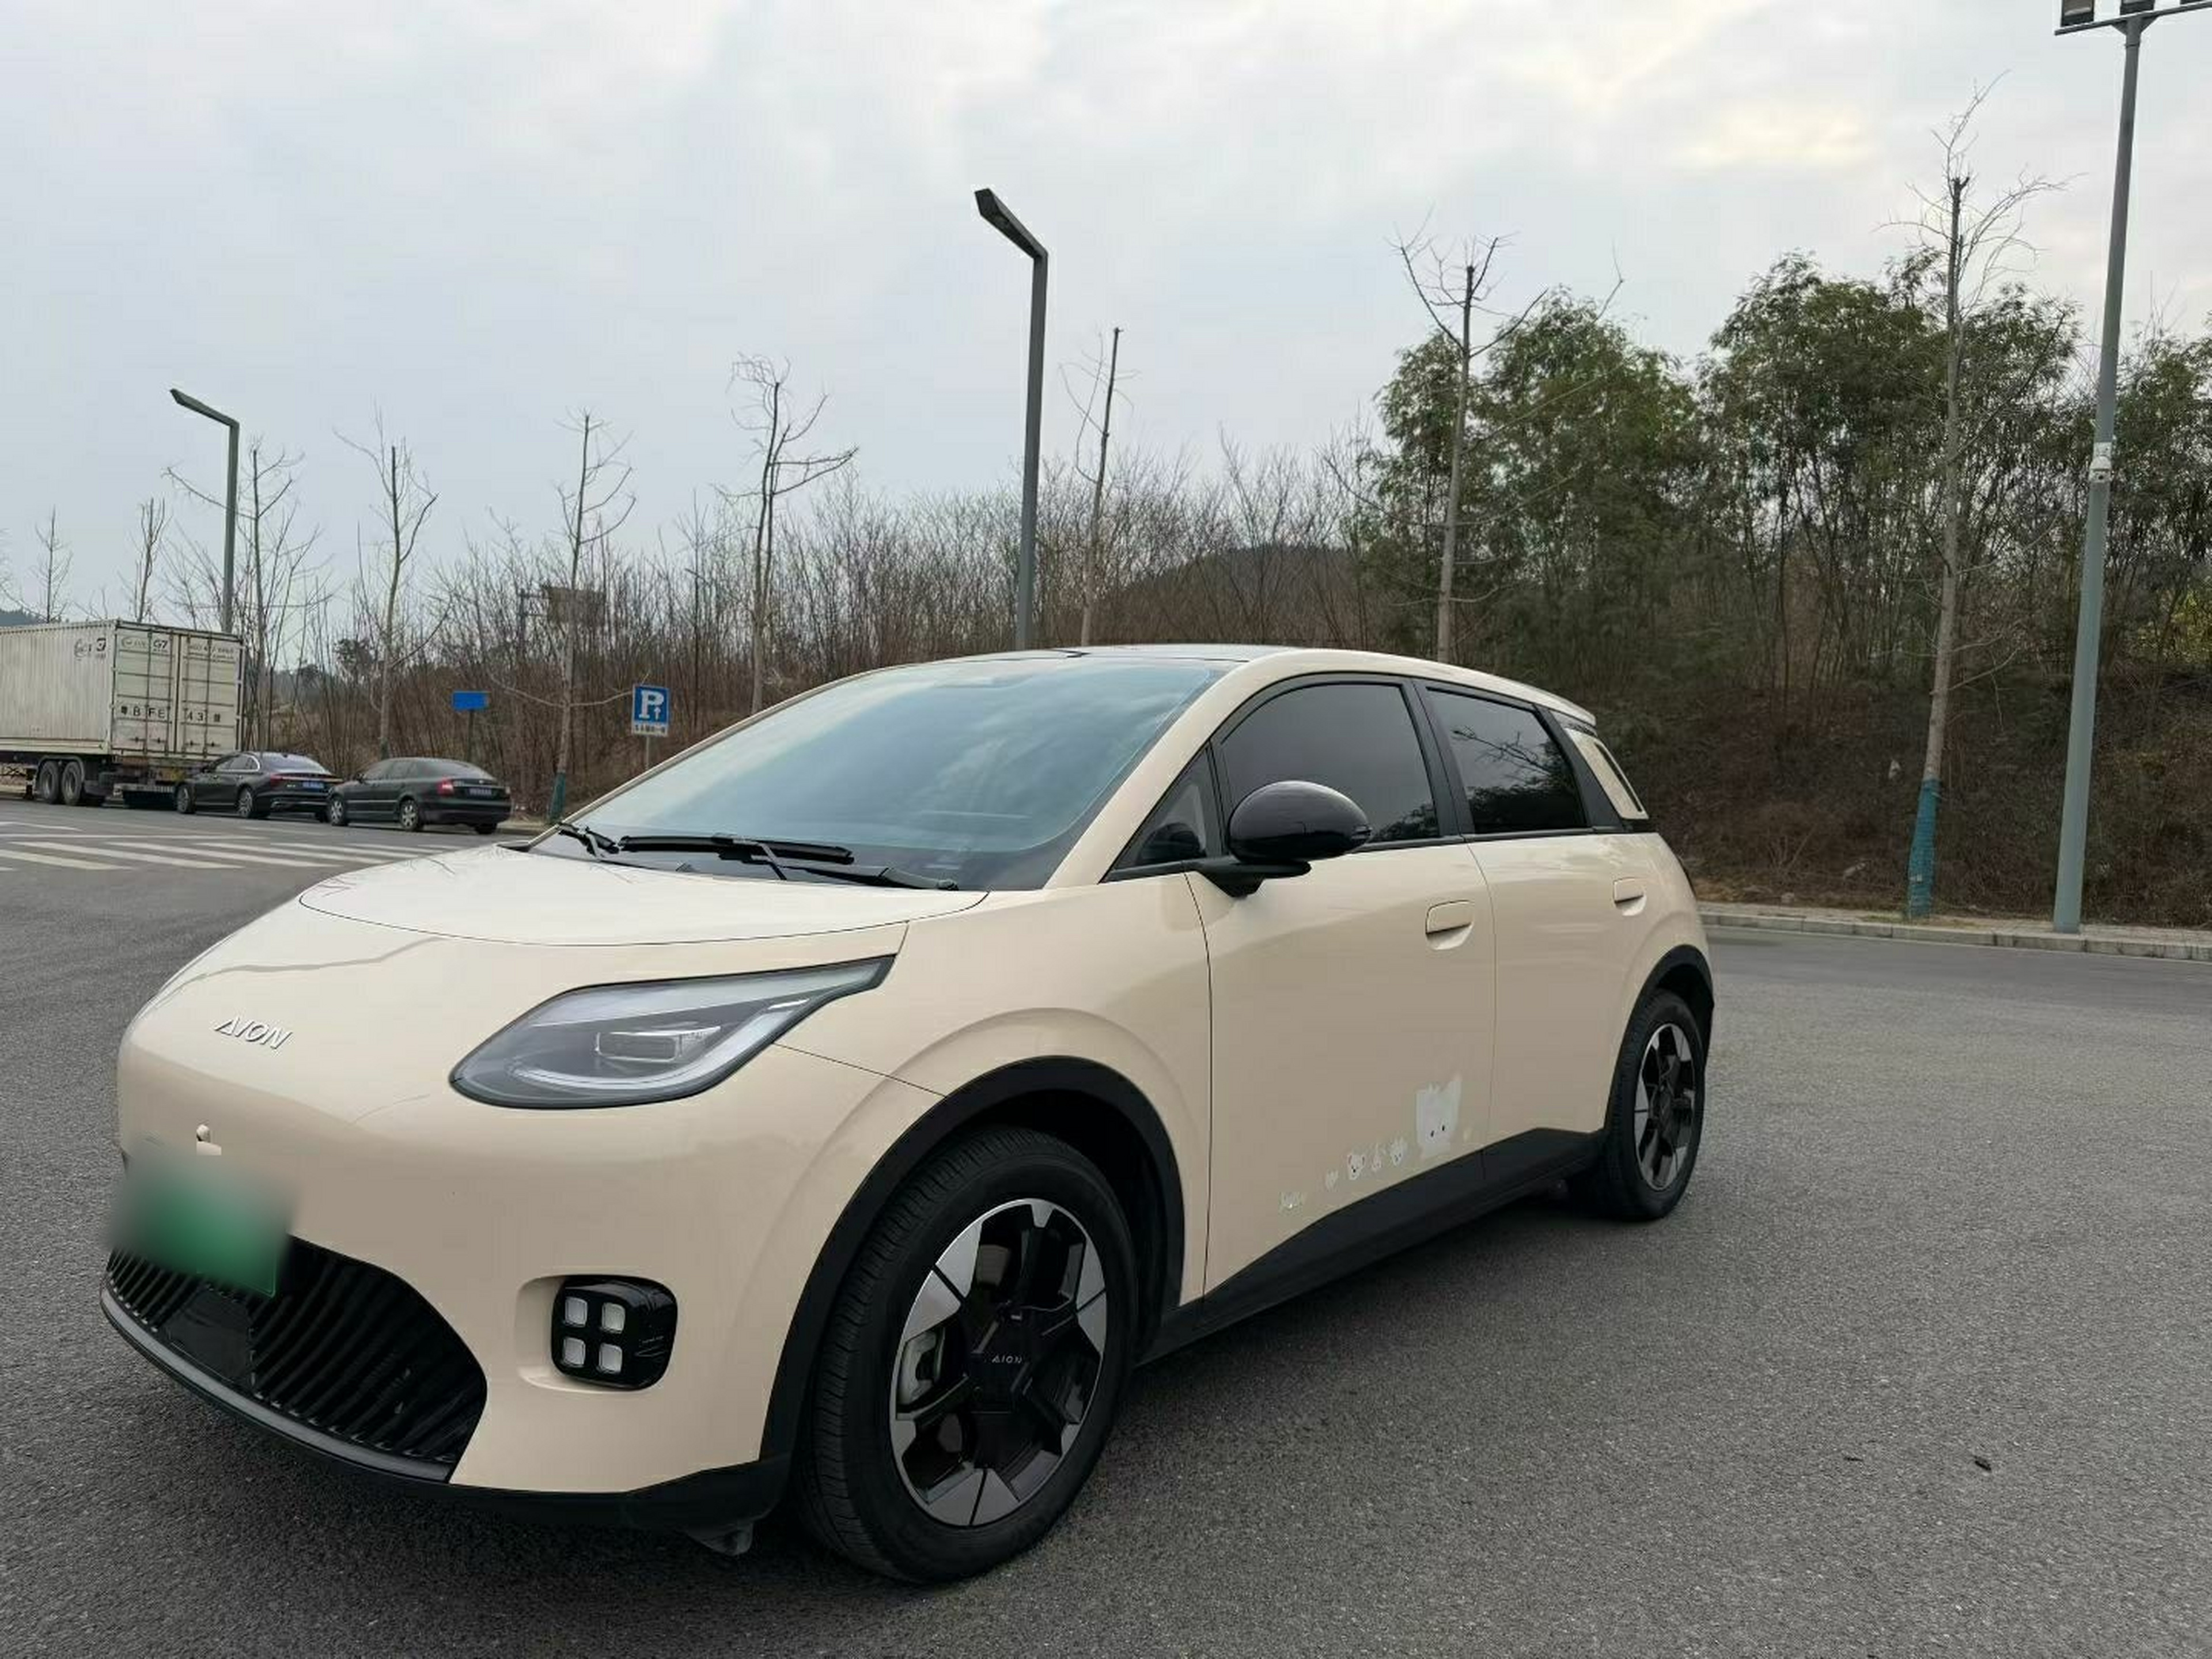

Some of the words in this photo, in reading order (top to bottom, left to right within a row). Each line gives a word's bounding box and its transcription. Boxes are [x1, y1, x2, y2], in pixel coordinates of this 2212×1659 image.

[639, 690, 664, 718] P
[213, 1017, 293, 1050] AION
[991, 1355, 1023, 1363] AION
